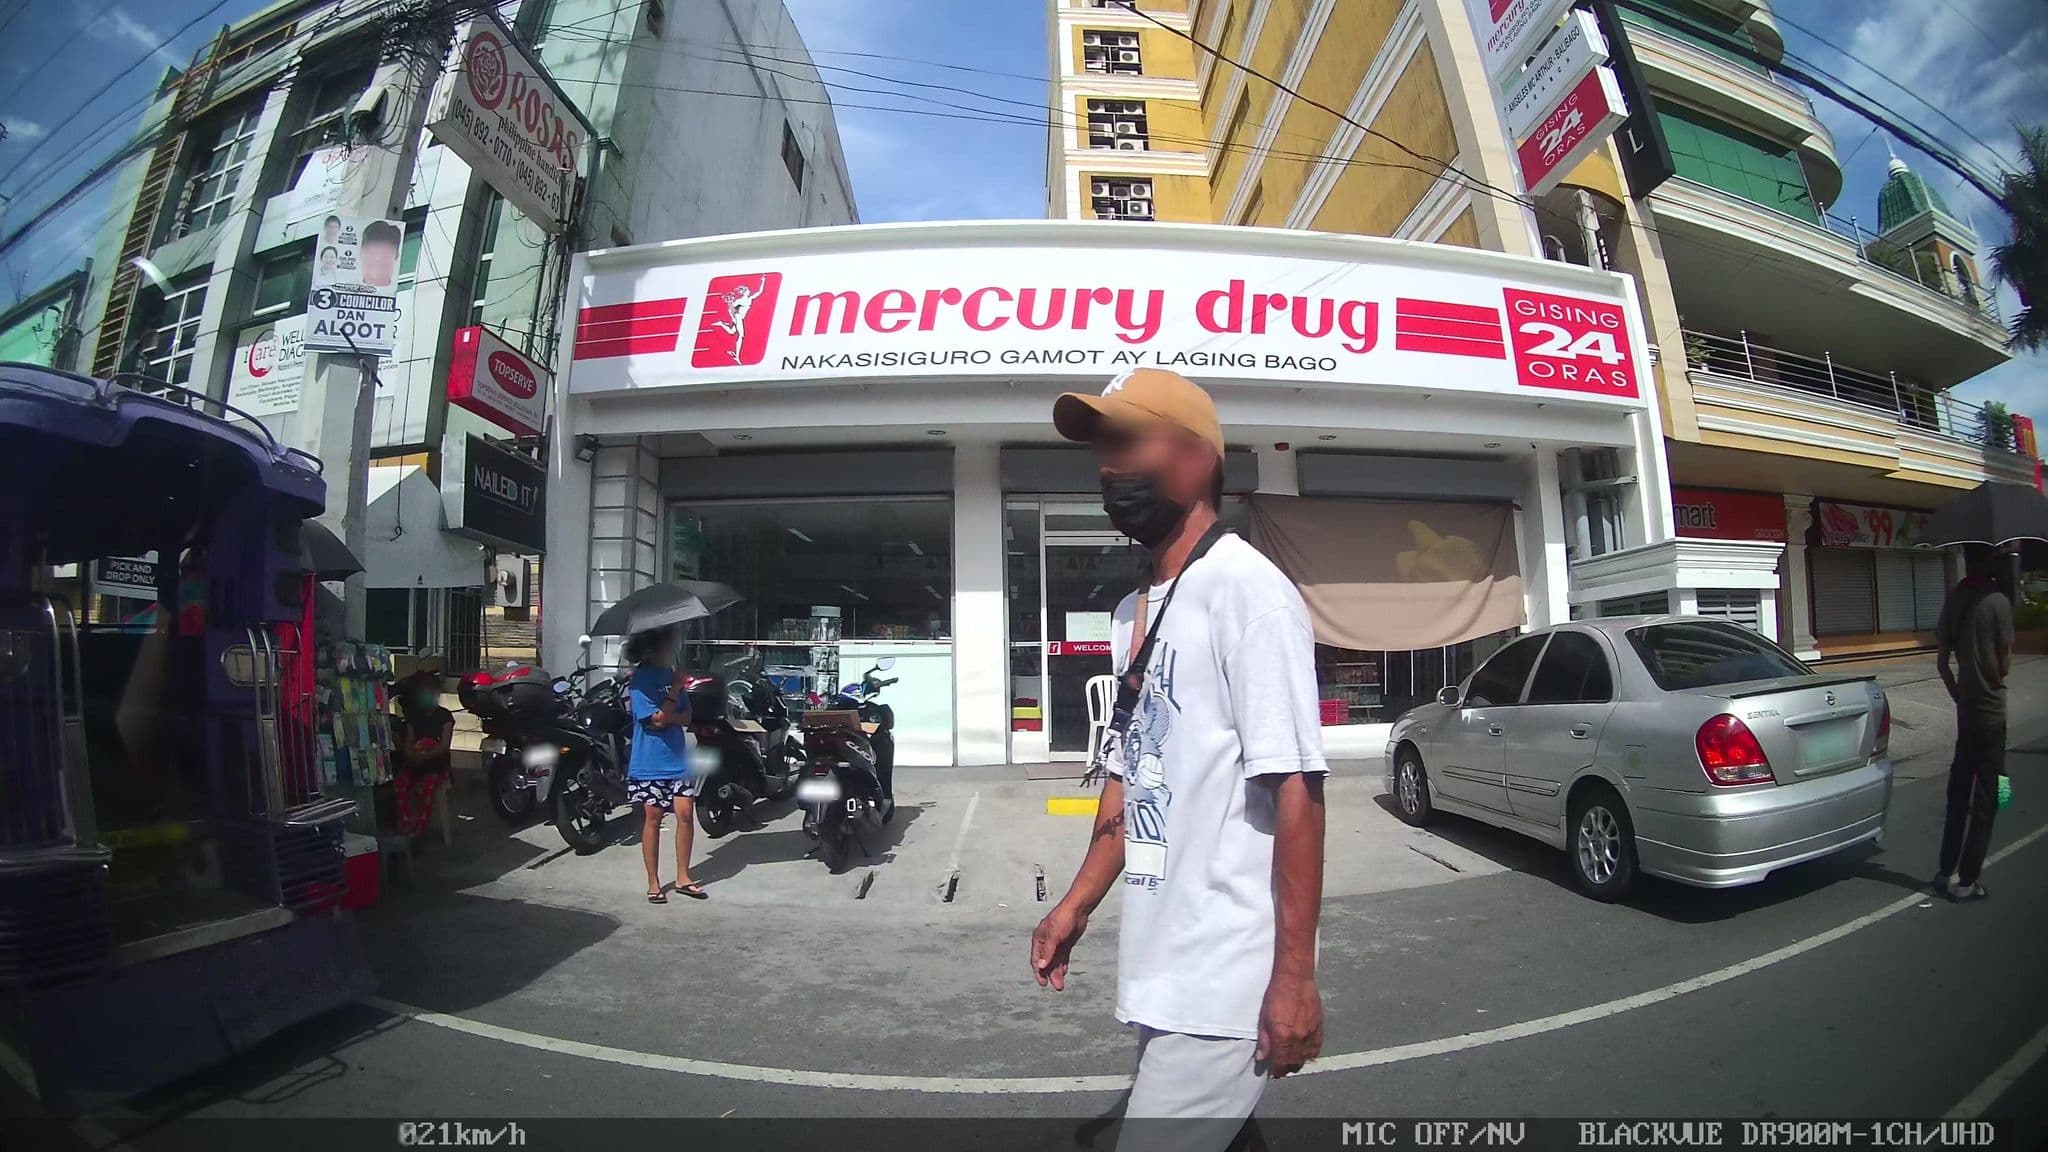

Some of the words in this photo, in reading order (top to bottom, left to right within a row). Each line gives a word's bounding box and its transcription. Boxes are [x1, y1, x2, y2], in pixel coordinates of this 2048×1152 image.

[507, 71, 577, 173] ROSAS
[1536, 93, 1579, 141] GISING
[1539, 106, 1584, 161] 24
[452, 95, 474, 136] (045)
[474, 118, 490, 146] 892
[494, 140, 512, 169] 0770
[516, 157, 535, 197] (045)
[534, 178, 548, 201] 892
[498, 115, 536, 160] philippine
[1544, 124, 1586, 166] ORAS
[316, 291, 332, 307] 3
[340, 294, 394, 311] COUNCILOR
[337, 310, 365, 321] DAN
[789, 286, 1164, 344] mercury
[1195, 279, 1379, 354] drug
[1515, 298, 1620, 329] GISING
[314, 319, 386, 340] ALOOT
[1518, 321, 1625, 366] 24
[494, 358, 534, 392] TOPSERVE
[782, 350, 990, 370] NAKASISIGURO
[1000, 349, 1104, 365] GAMOT
[1111, 350, 1147, 366] AY
[1155, 350, 1257, 369] LAGING
[1264, 353, 1337, 371] BAGO
[1528, 360, 1629, 388] ORAS
[474, 464, 518, 501] NAILED
[106, 571, 131, 582] DROP
[132, 574, 156, 585] ONLY
[111, 561, 132, 572] PICK
[131, 564, 152, 574] AND
[1073, 644, 1111, 652] WELCOM
